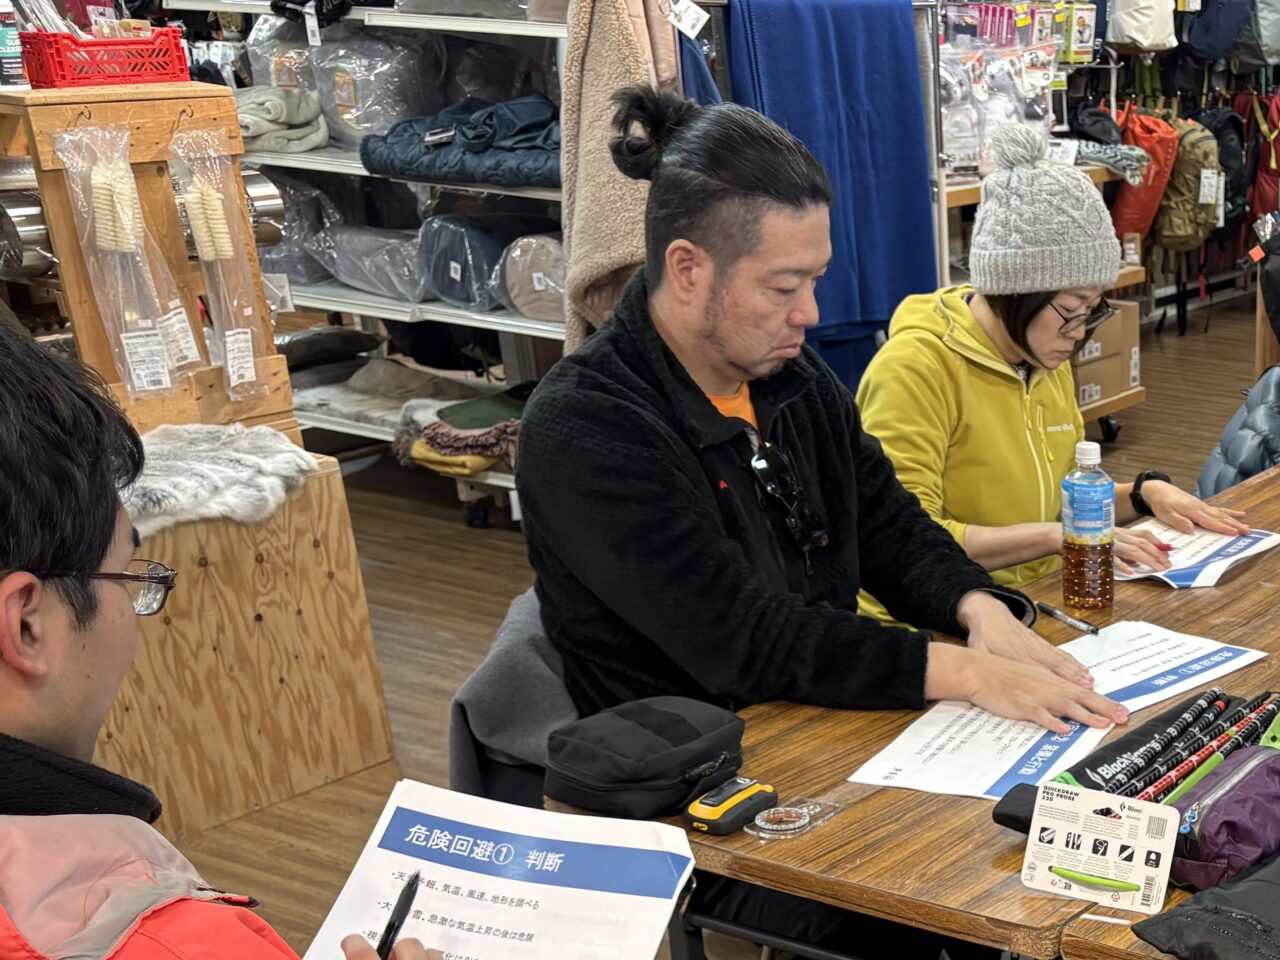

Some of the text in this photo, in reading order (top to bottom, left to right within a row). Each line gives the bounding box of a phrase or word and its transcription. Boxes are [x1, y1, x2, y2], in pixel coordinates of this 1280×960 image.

[1042, 785, 1080, 797] QUICKDRAW
[1055, 793, 1076, 802] PROBE
[404, 823, 566, 874] 危険回避① 判断
